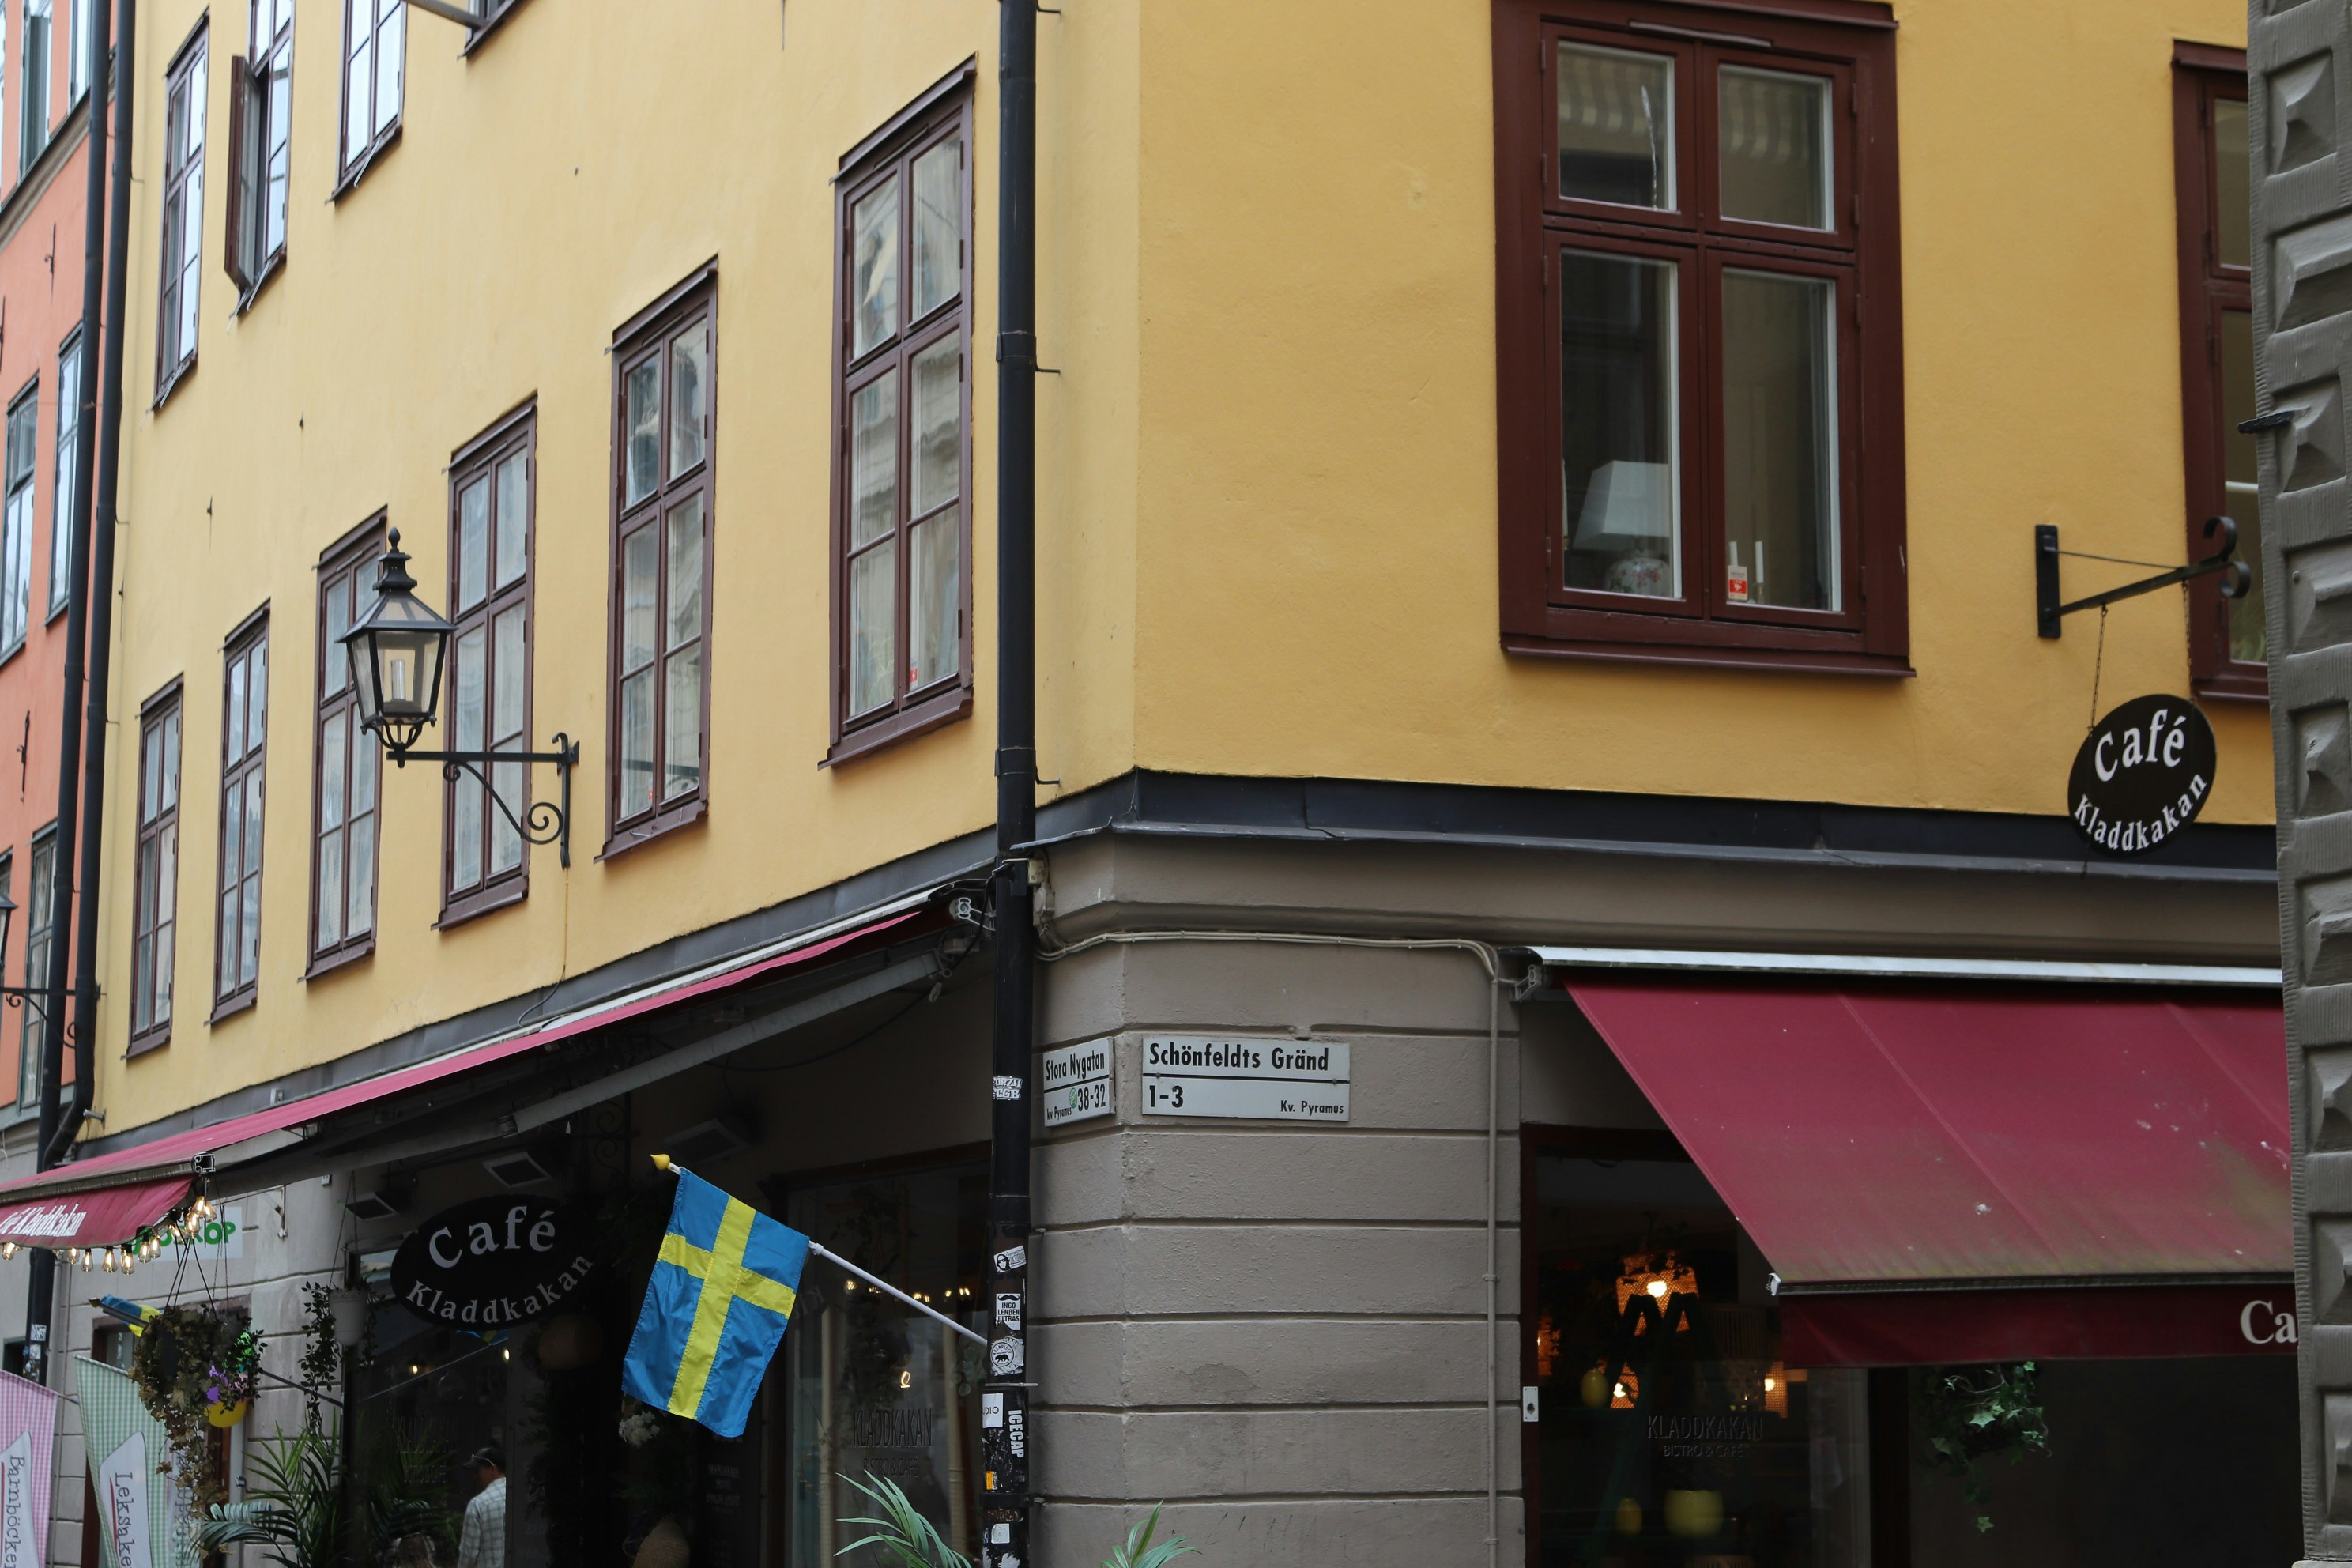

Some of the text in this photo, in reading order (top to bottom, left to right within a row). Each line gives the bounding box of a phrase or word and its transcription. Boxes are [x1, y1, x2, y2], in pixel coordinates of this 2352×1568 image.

[2094, 709, 2187, 782] Café
[2074, 774, 2207, 852] Kladdkakan
[1046, 1050, 1105, 1081] Stora Nygatan
[1149, 1042, 1329, 1071] Schönfeldts Gränd
[993, 1076, 1022, 1088] ORZA
[1149, 1084, 1184, 1108] 1-3
[1077, 1084, 1106, 1112] 38-32
[1280, 1099, 1344, 1116] Kv. Pyramus
[428, 1205, 556, 1268] Café
[406, 1254, 594, 1324] Kladdkakan
[2240, 1299, 2298, 1344] Ca
[854, 1408, 933, 1448] KLADDKAKAN
[1008, 1409, 1024, 1458] ICECAP
[1647, 1415, 1764, 1440] KLADDKAKAN
[1664, 1445, 1703, 1457] BISTRO
